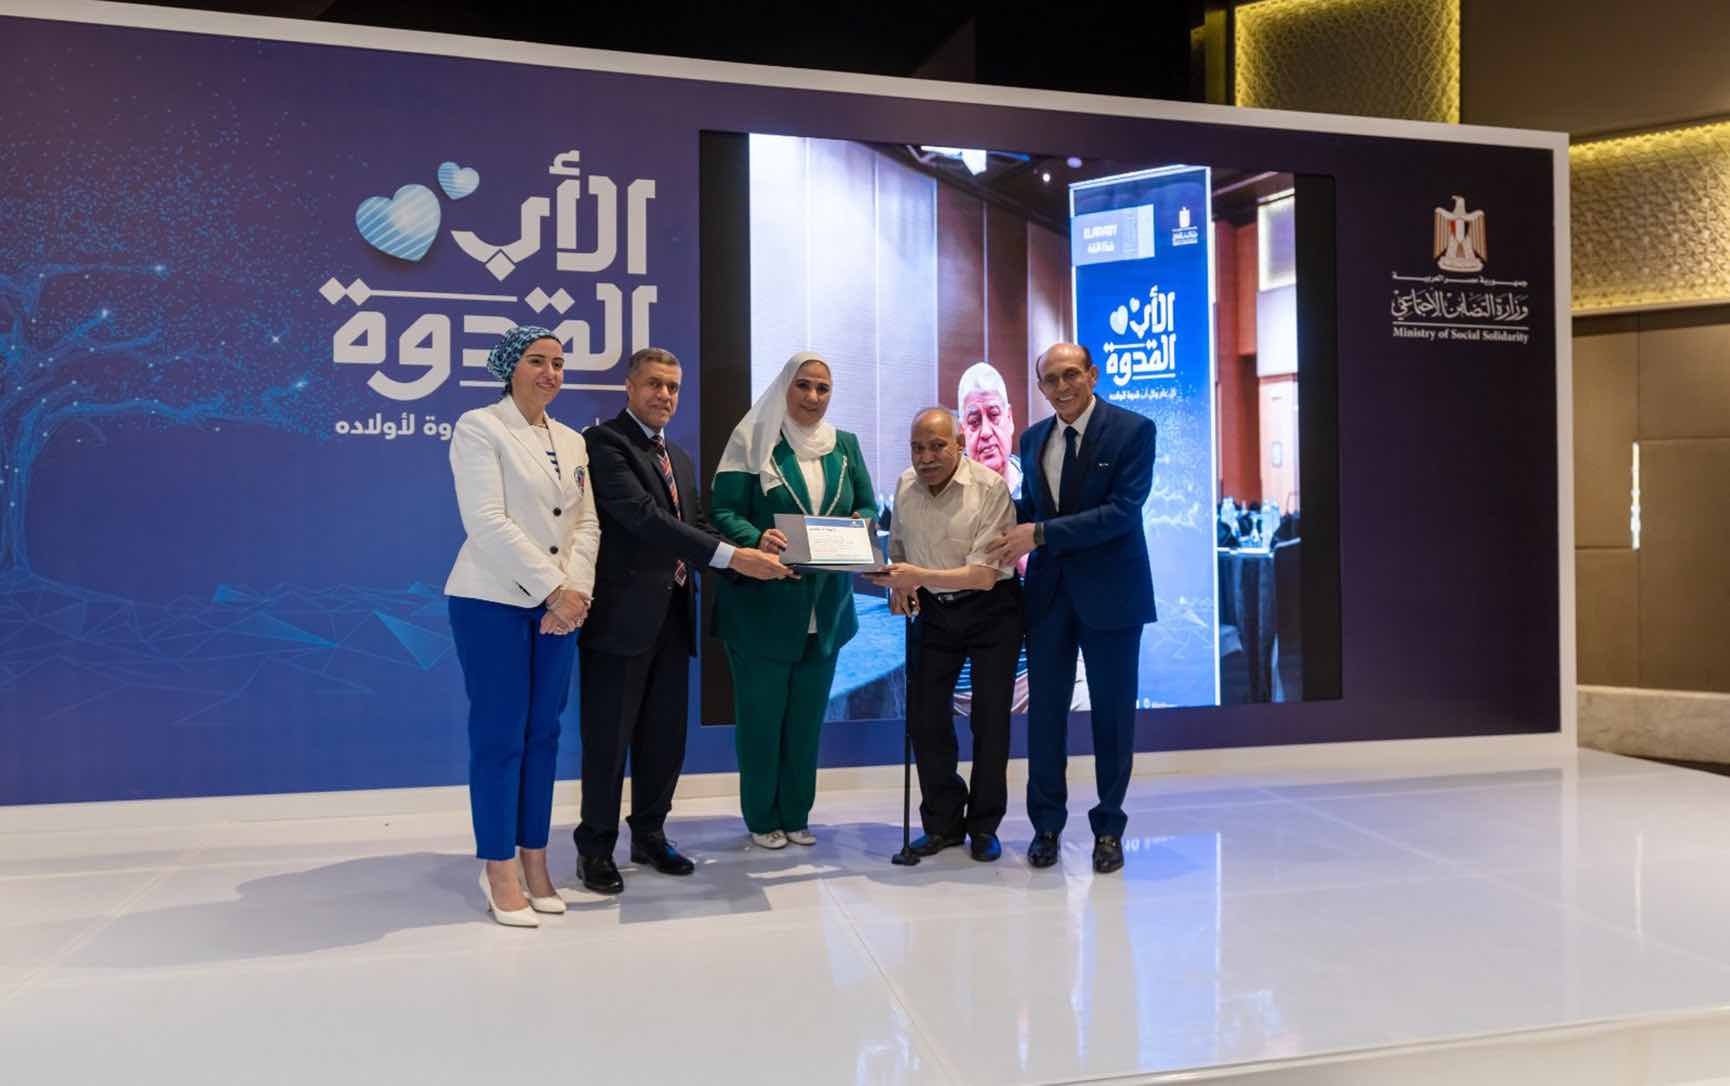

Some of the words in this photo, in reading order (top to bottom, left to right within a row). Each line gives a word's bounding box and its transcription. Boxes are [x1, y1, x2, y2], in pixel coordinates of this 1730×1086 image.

[449, 149, 656, 282] الأب
[1129, 284, 1176, 339] الأب
[1392, 326, 1436, 341] Ministry
[1438, 328, 1449, 339] of
[1451, 329, 1480, 340] Social
[1482, 330, 1529, 344] Solidarity
[1103, 332, 1177, 387] القدوة
[335, 411, 416, 440] لأولاده
[423, 415, 453, 441] وة
